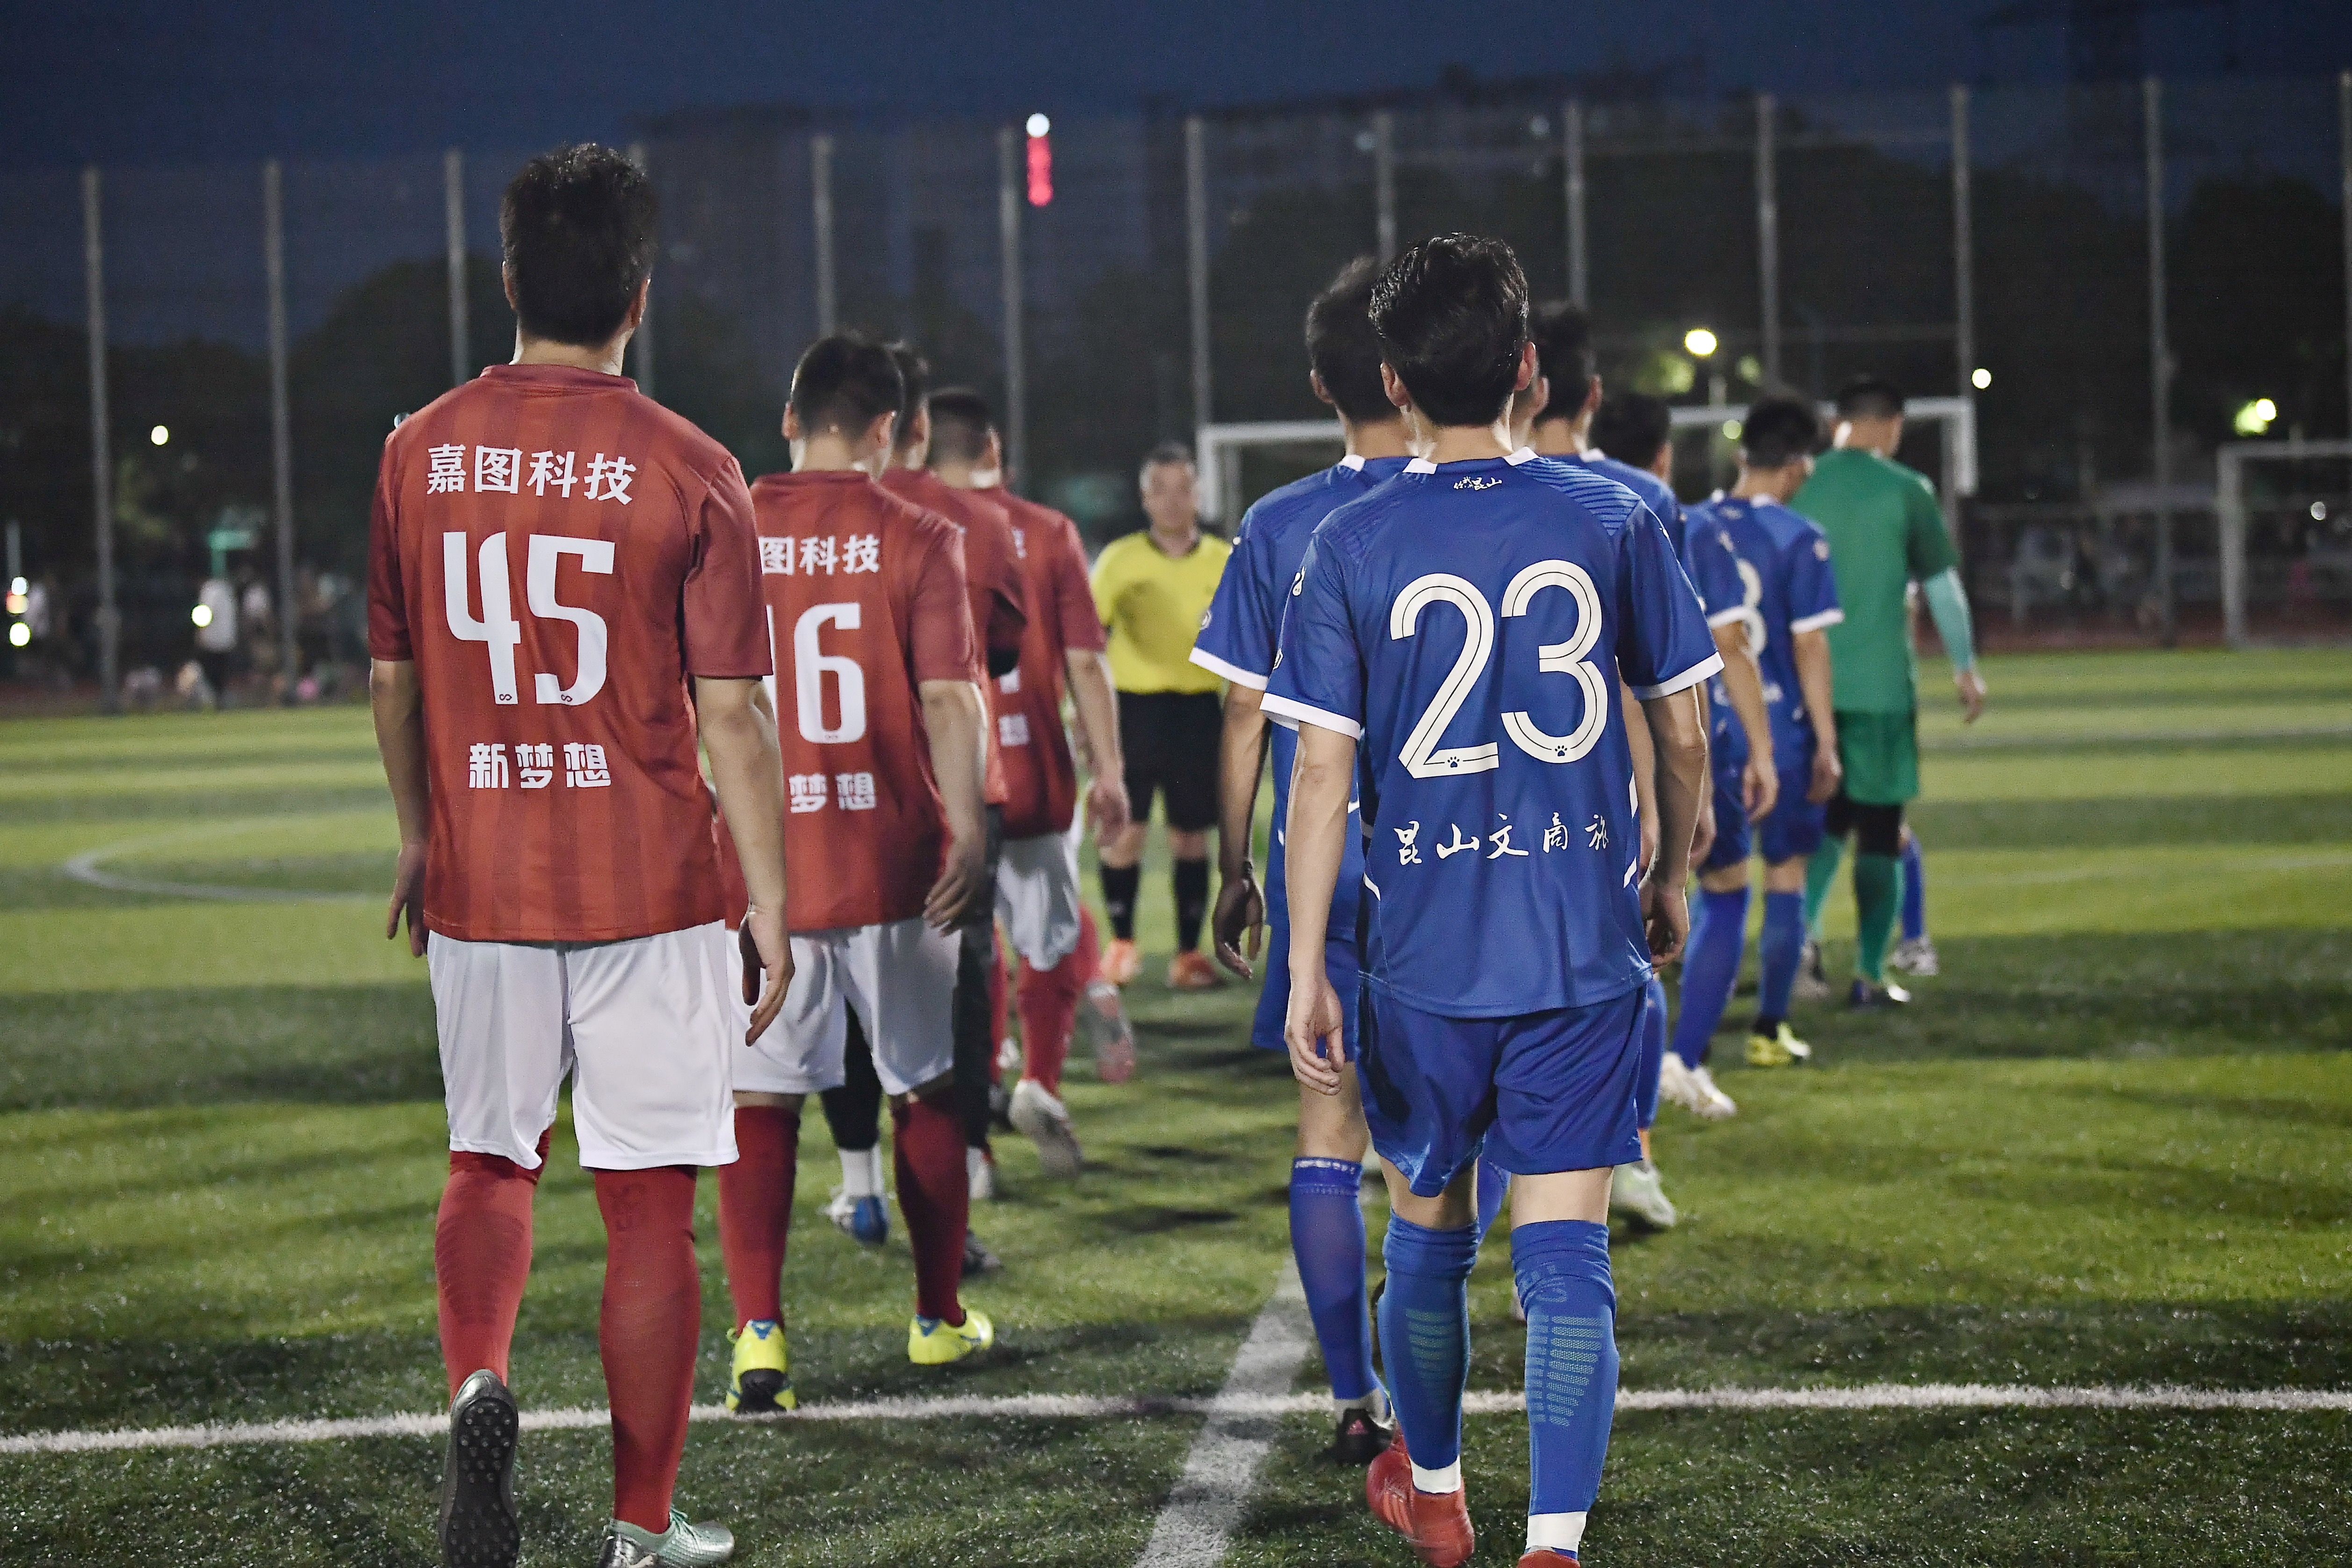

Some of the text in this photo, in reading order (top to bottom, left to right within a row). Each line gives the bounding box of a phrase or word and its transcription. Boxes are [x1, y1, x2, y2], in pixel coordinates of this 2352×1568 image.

[426, 443, 637, 505] 嘉图科技
[758, 534, 880, 576] 图科技
[442, 531, 616, 706] 45
[1389, 559, 1609, 779] 23
[469, 741, 612, 789] 新梦想
[788, 772, 876, 813] 梦想
